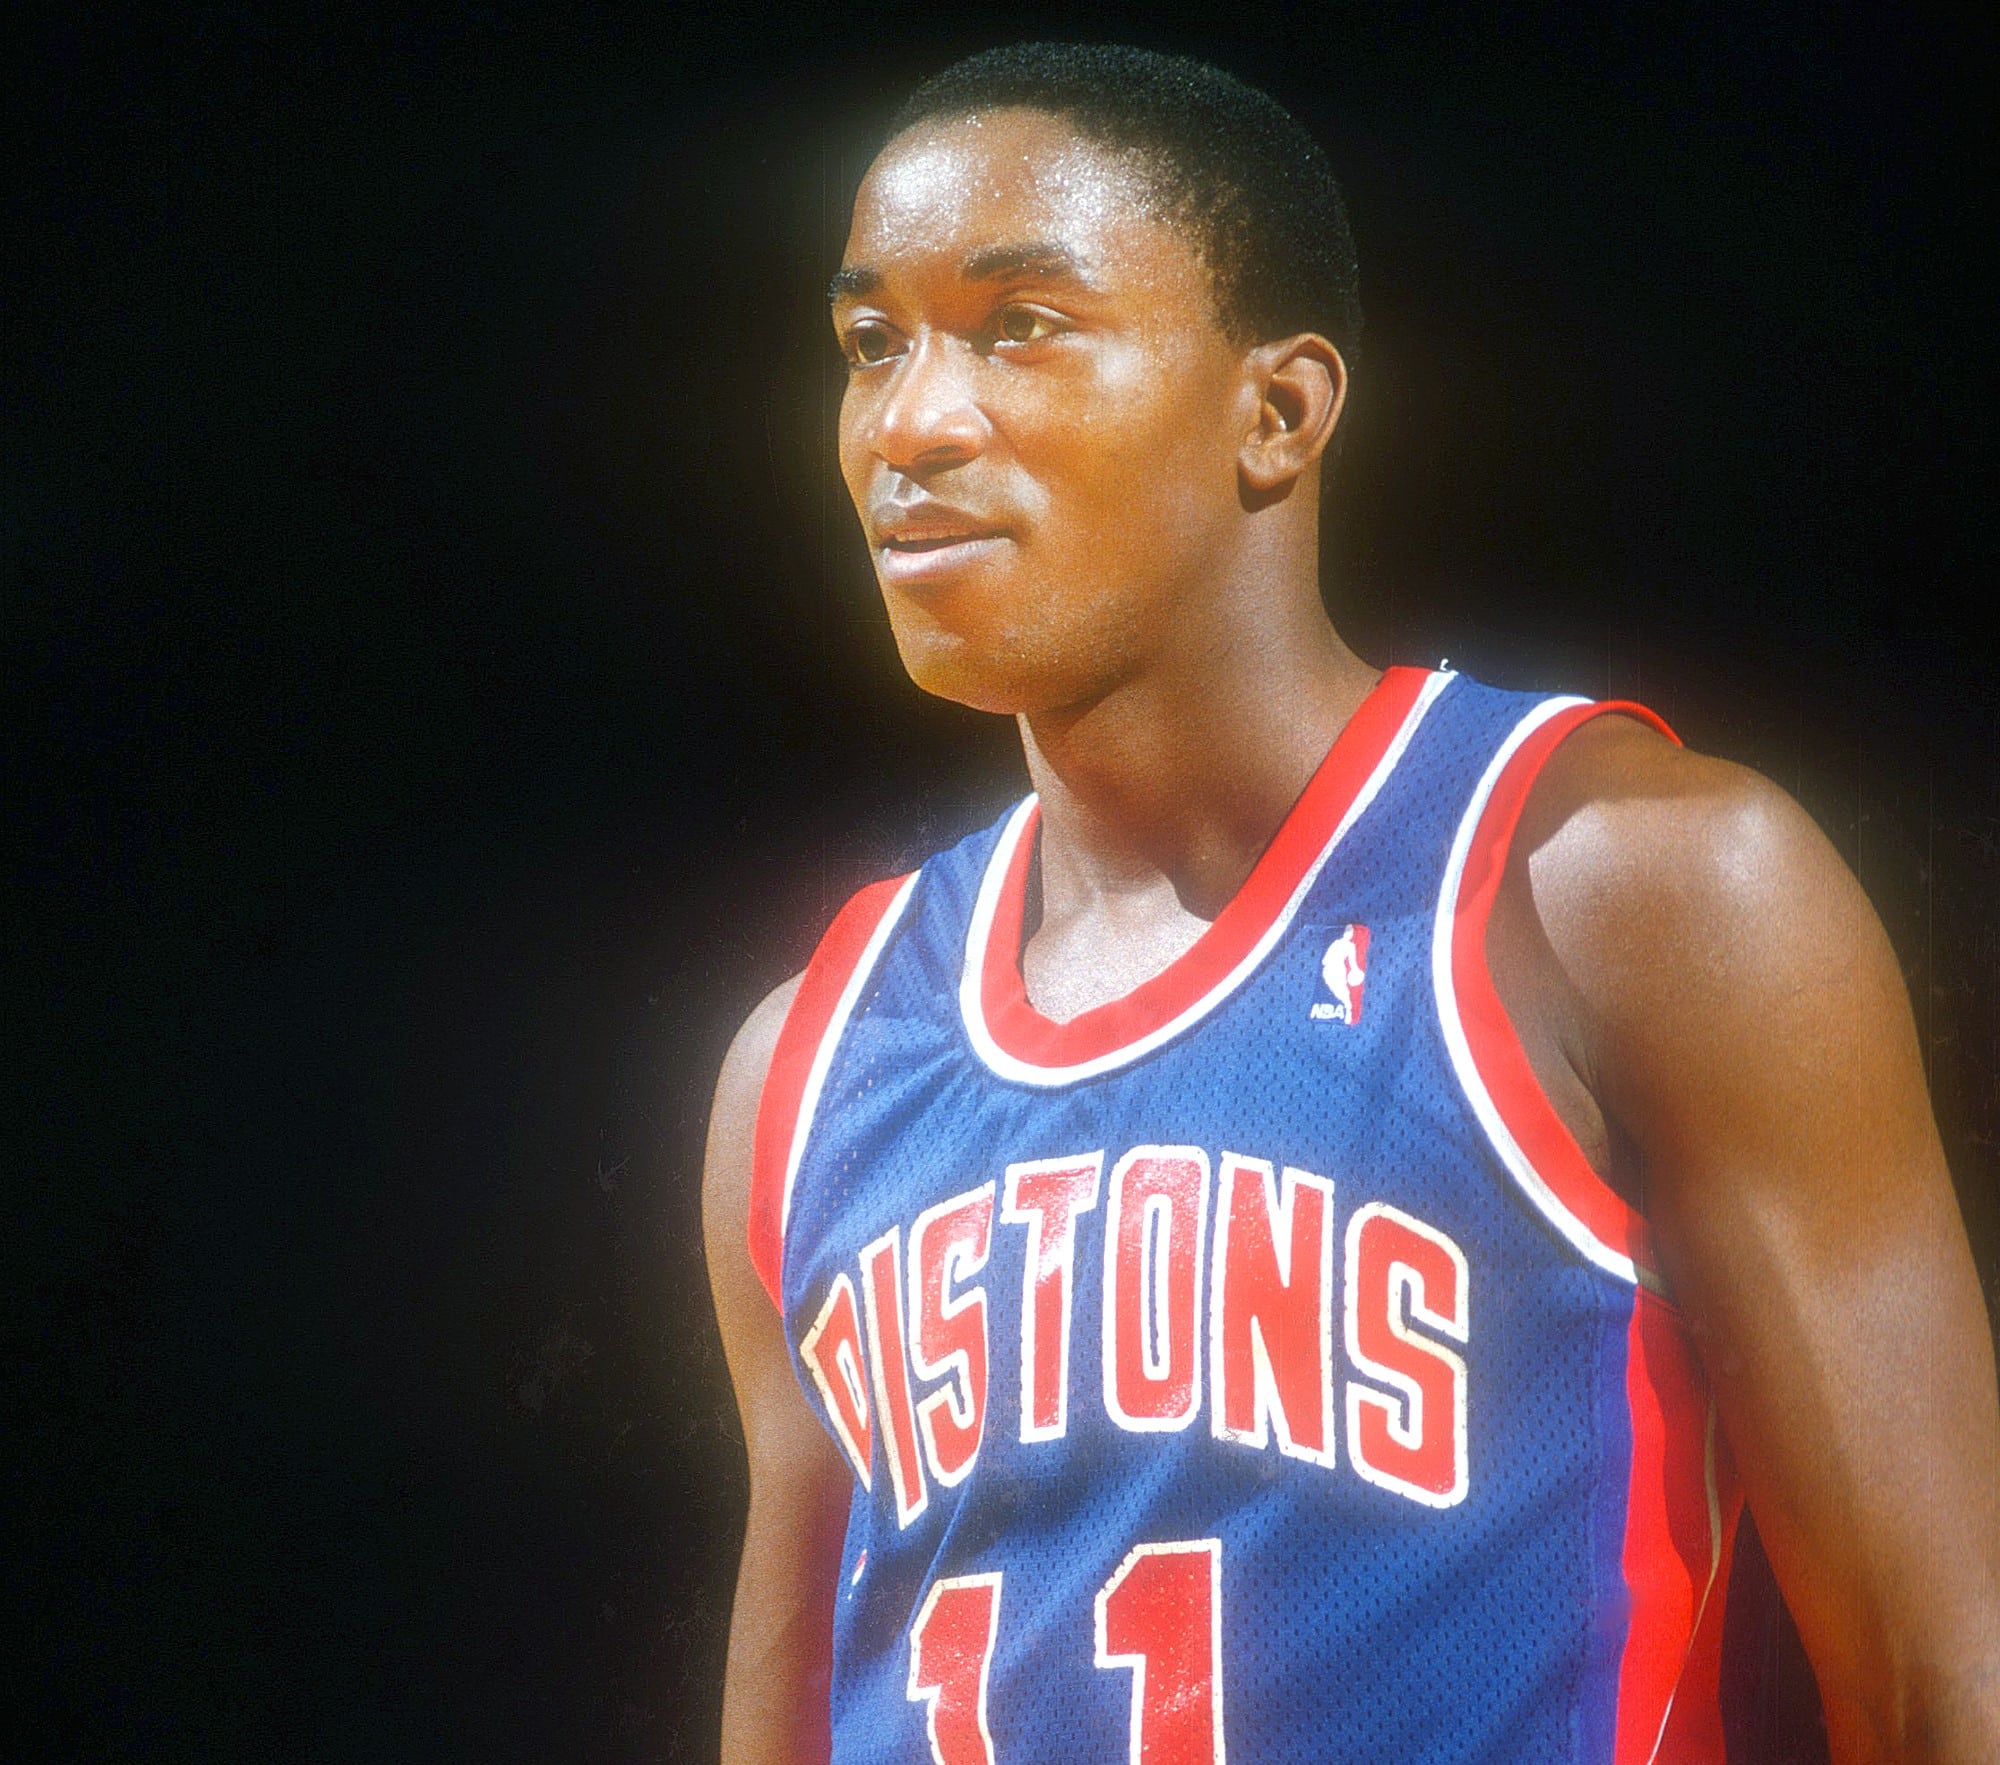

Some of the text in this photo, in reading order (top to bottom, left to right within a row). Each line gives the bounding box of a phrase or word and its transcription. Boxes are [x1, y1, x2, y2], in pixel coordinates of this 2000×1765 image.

[1310, 1003, 1345, 1020] NBA
[800, 1144, 1470, 1531] PISTONS
[906, 1537, 1226, 1765] 11
